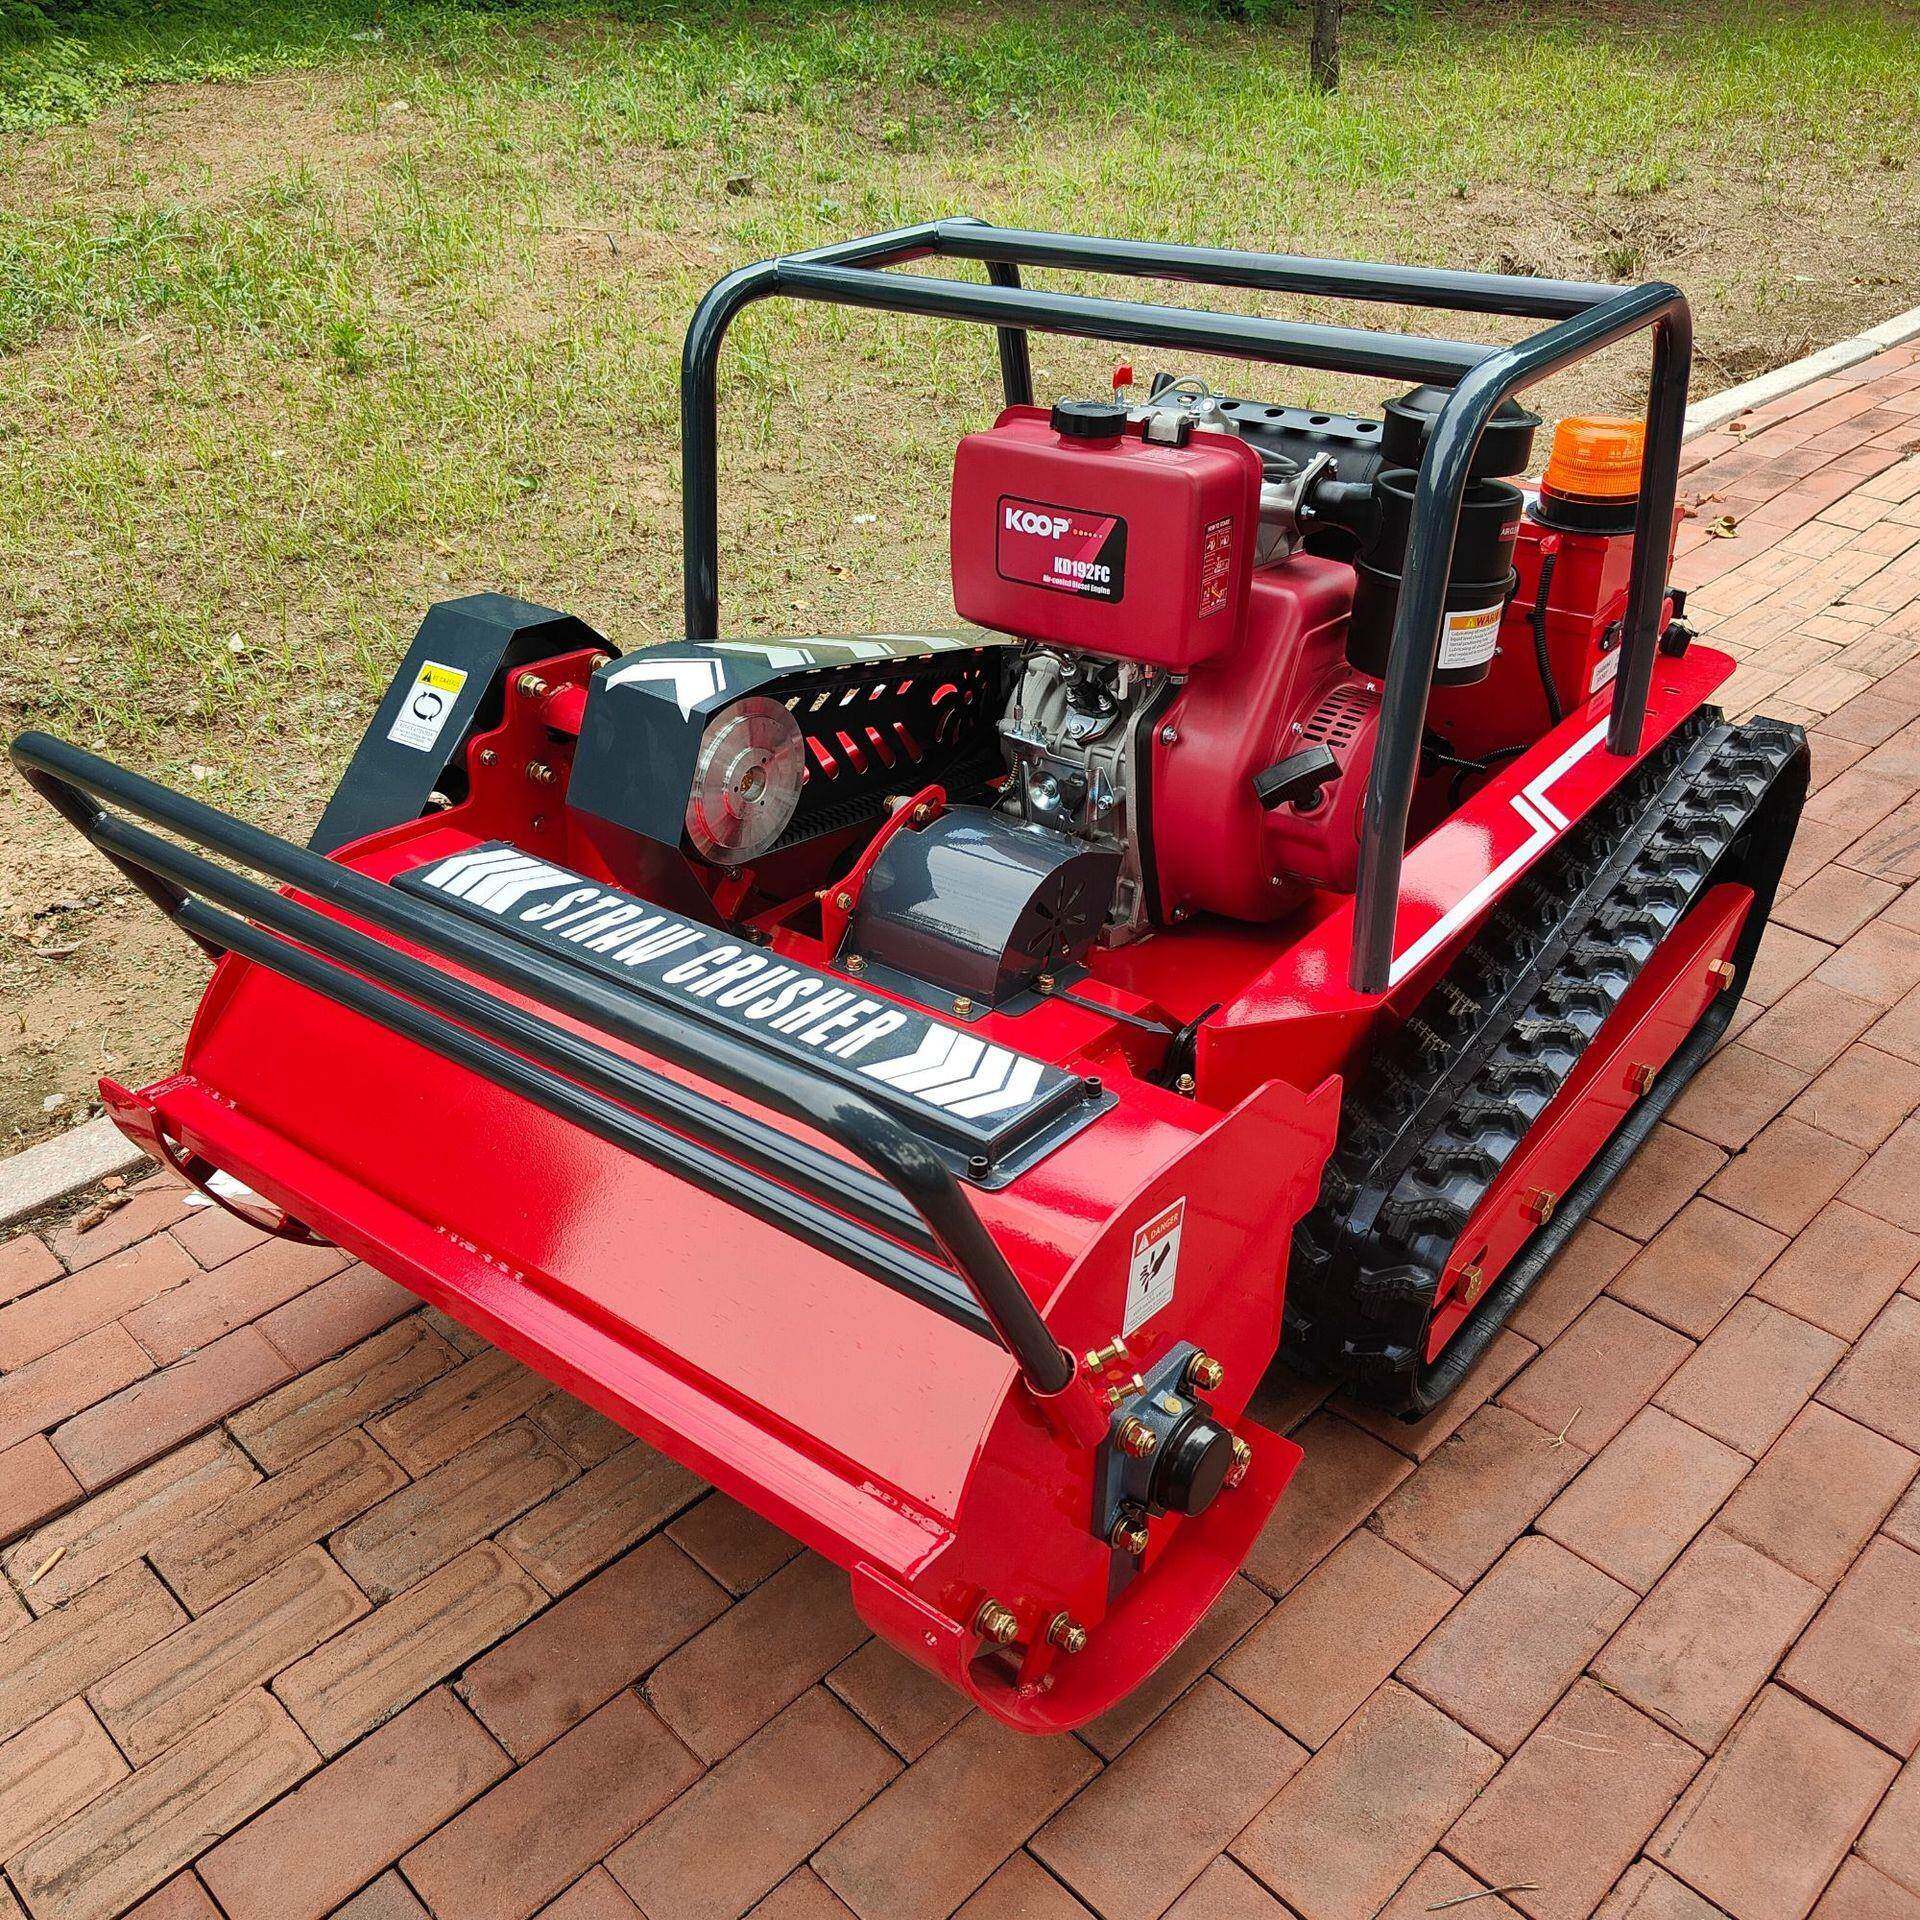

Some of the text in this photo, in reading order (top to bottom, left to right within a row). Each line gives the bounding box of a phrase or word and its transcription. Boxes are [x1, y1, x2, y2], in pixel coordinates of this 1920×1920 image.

[1005, 507, 1069, 540] KOOP
[1054, 556, 1111, 583] KD192FC
[1042, 574, 1111, 595] Air-cooled Diesel Engine
[1476, 610, 1500, 627] WARN
[519, 888, 907, 1059] STRAW CRUSHER
[1150, 1212, 1179, 1241] DANGER
